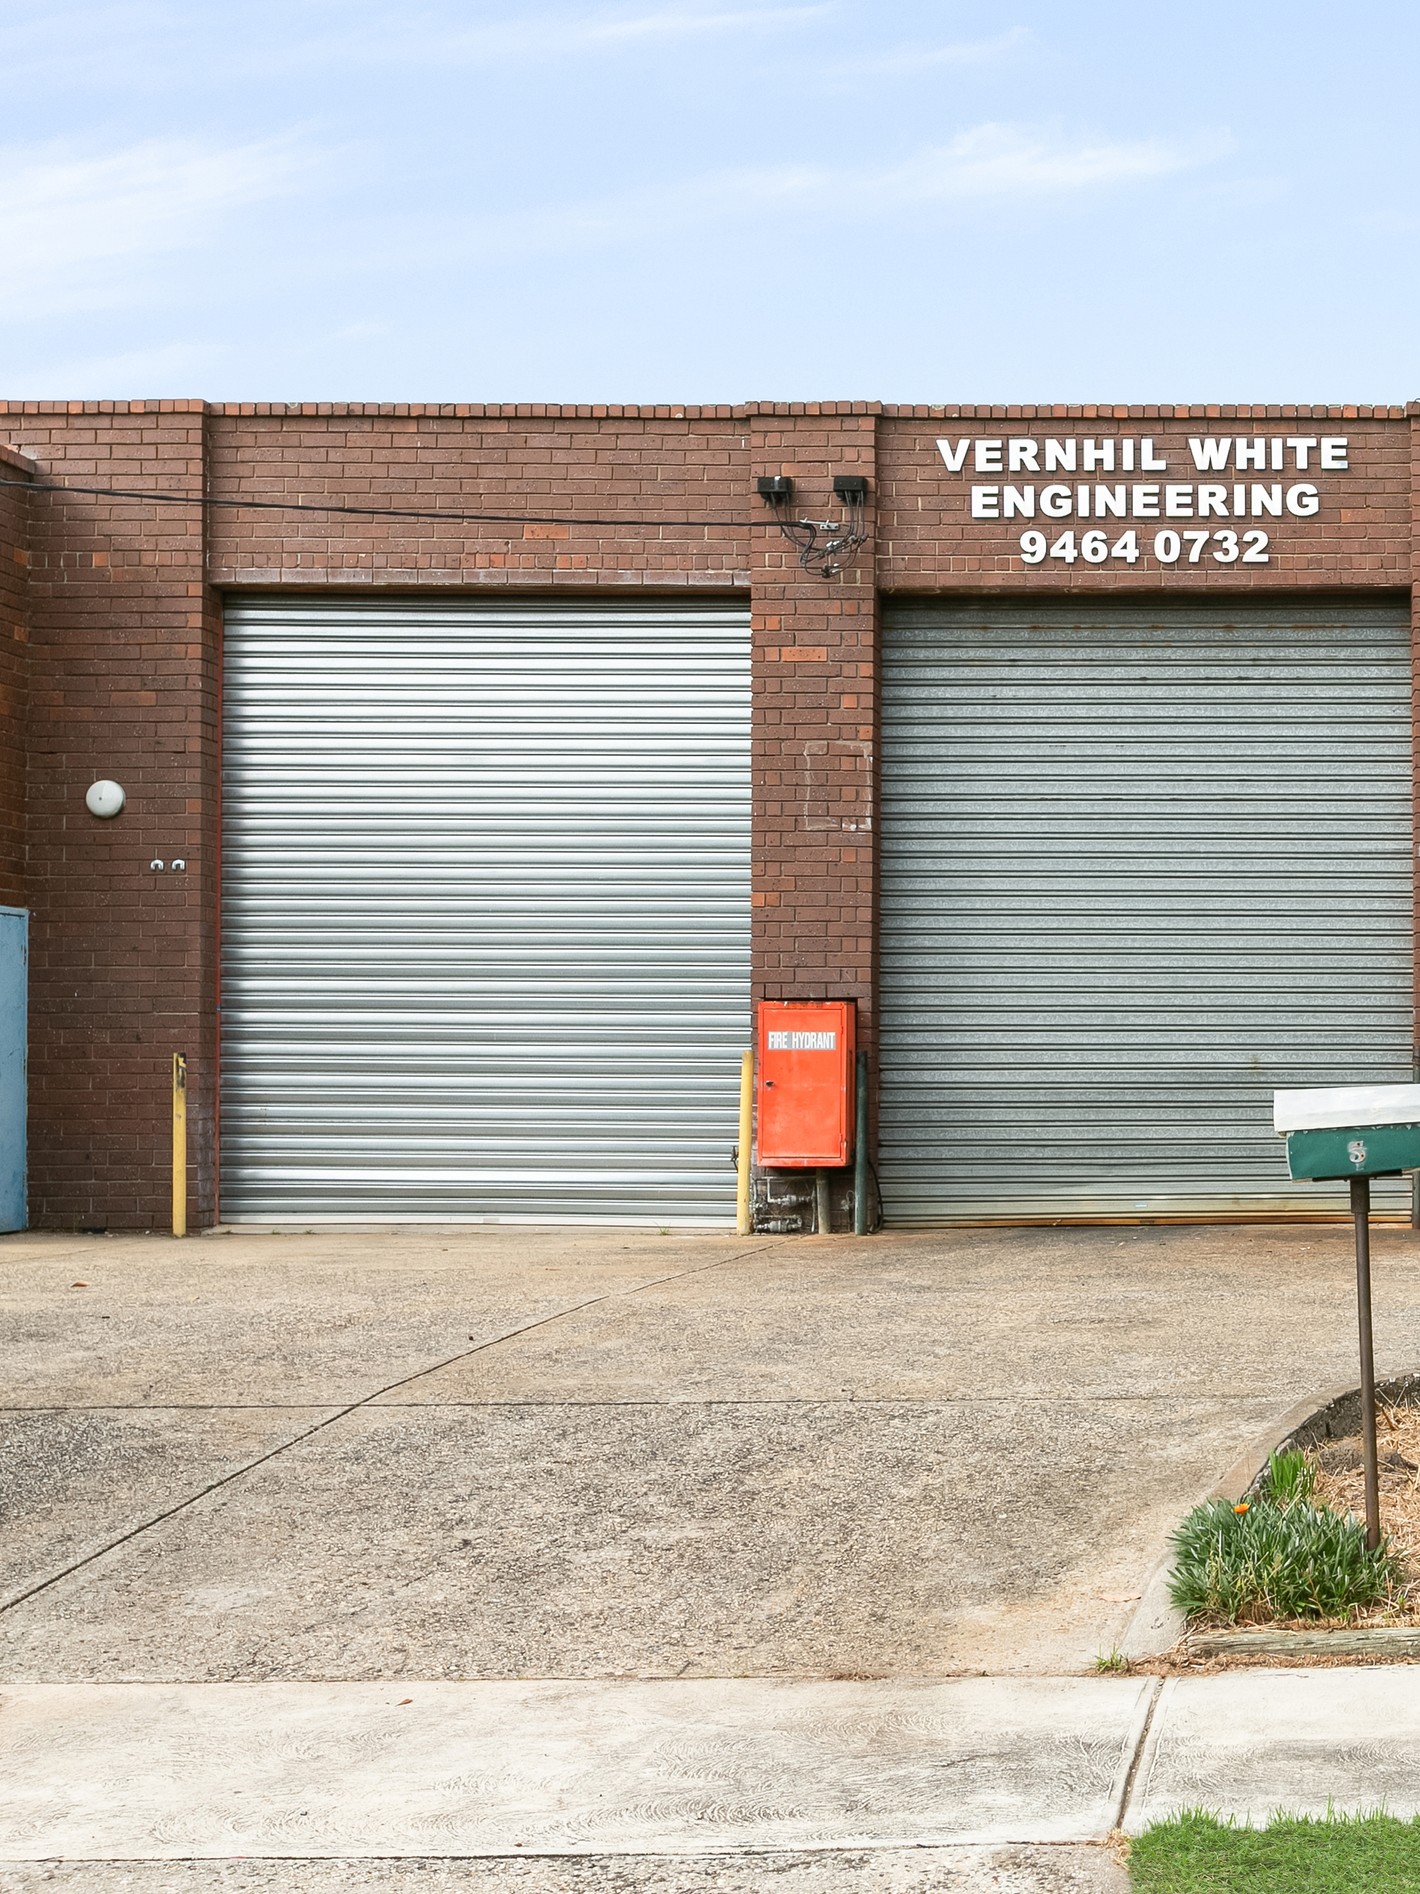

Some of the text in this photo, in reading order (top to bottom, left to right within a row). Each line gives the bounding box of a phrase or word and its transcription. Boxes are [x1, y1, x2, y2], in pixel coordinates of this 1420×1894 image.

[937, 437, 1348, 471] VERNHIL WHITE
[971, 484, 1319, 518] ENGINEERING
[1020, 530, 1269, 563] 9464 0732
[768, 1031, 836, 1049] FIRE HYDRANT
